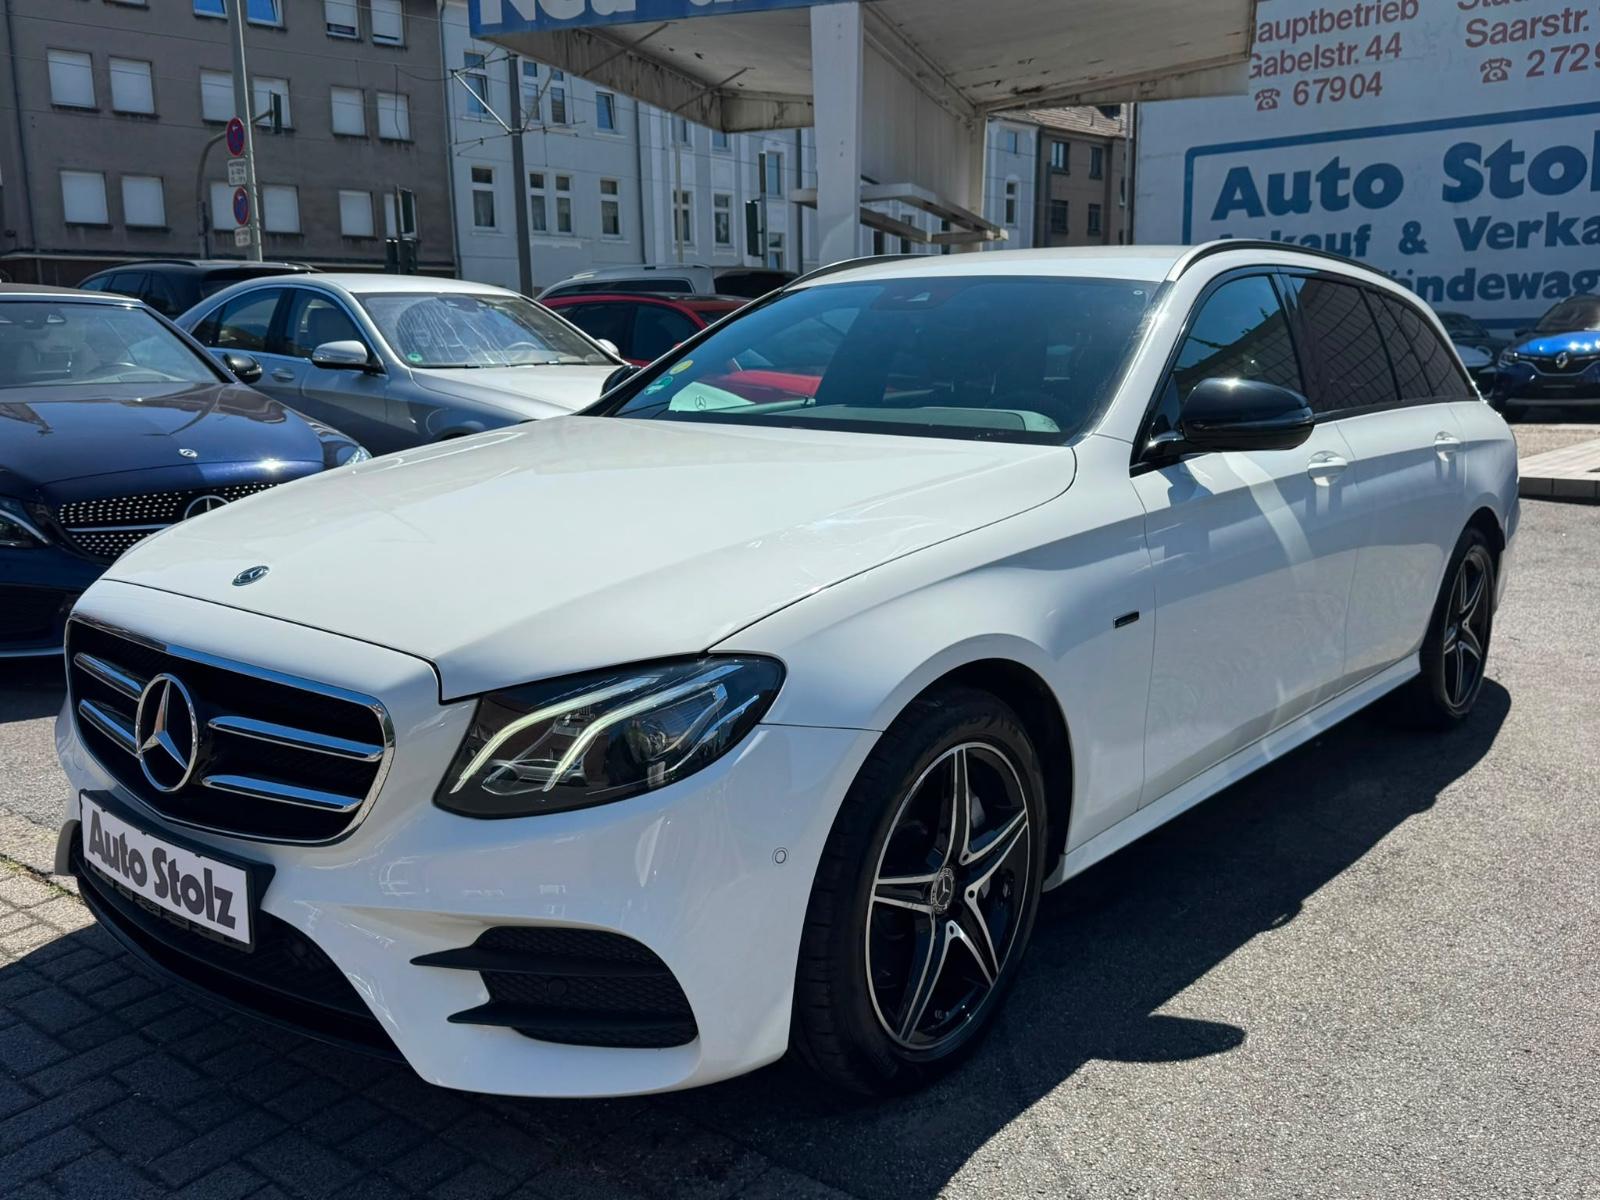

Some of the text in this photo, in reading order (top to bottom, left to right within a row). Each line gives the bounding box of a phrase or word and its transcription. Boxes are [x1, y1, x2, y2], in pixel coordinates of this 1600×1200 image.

[1255, 0, 1419, 45] auptbetrieb
[1465, 7, 1590, 48] Saarstr.
[1365, 32, 1403, 62] 44
[1210, 156, 1405, 221] Auto
[1220, 223, 1372, 258] auf
[1398, 220, 1430, 256] &
[88, 809, 236, 930] Auto Stolz
